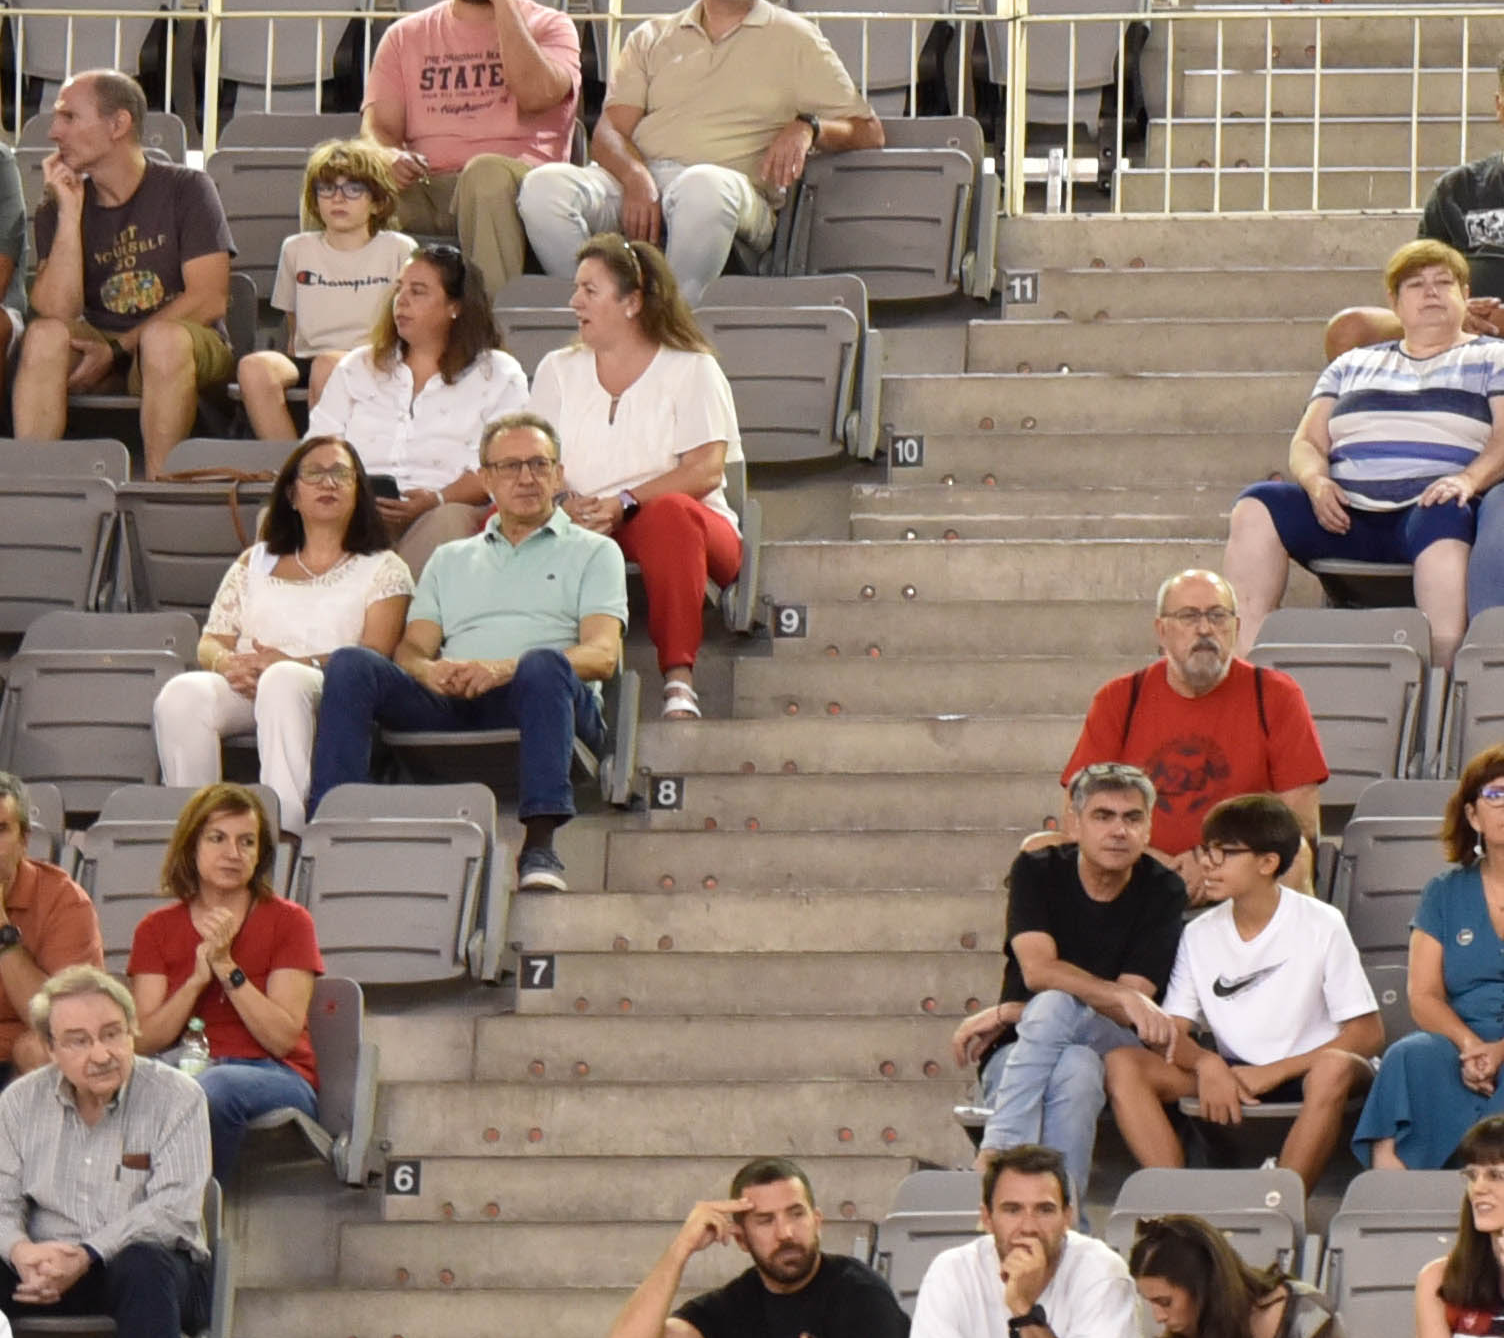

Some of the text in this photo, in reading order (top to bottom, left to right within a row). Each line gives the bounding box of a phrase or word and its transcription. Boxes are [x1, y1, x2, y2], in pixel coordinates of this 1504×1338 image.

[420, 63, 505, 91] STATE
[1010, 276, 1034, 301] 11
[895, 439, 919, 464] 10
[780, 608, 800, 634] 9
[657, 779, 678, 806] 8
[529, 959, 549, 986] 7
[393, 1164, 415, 1192] 6
